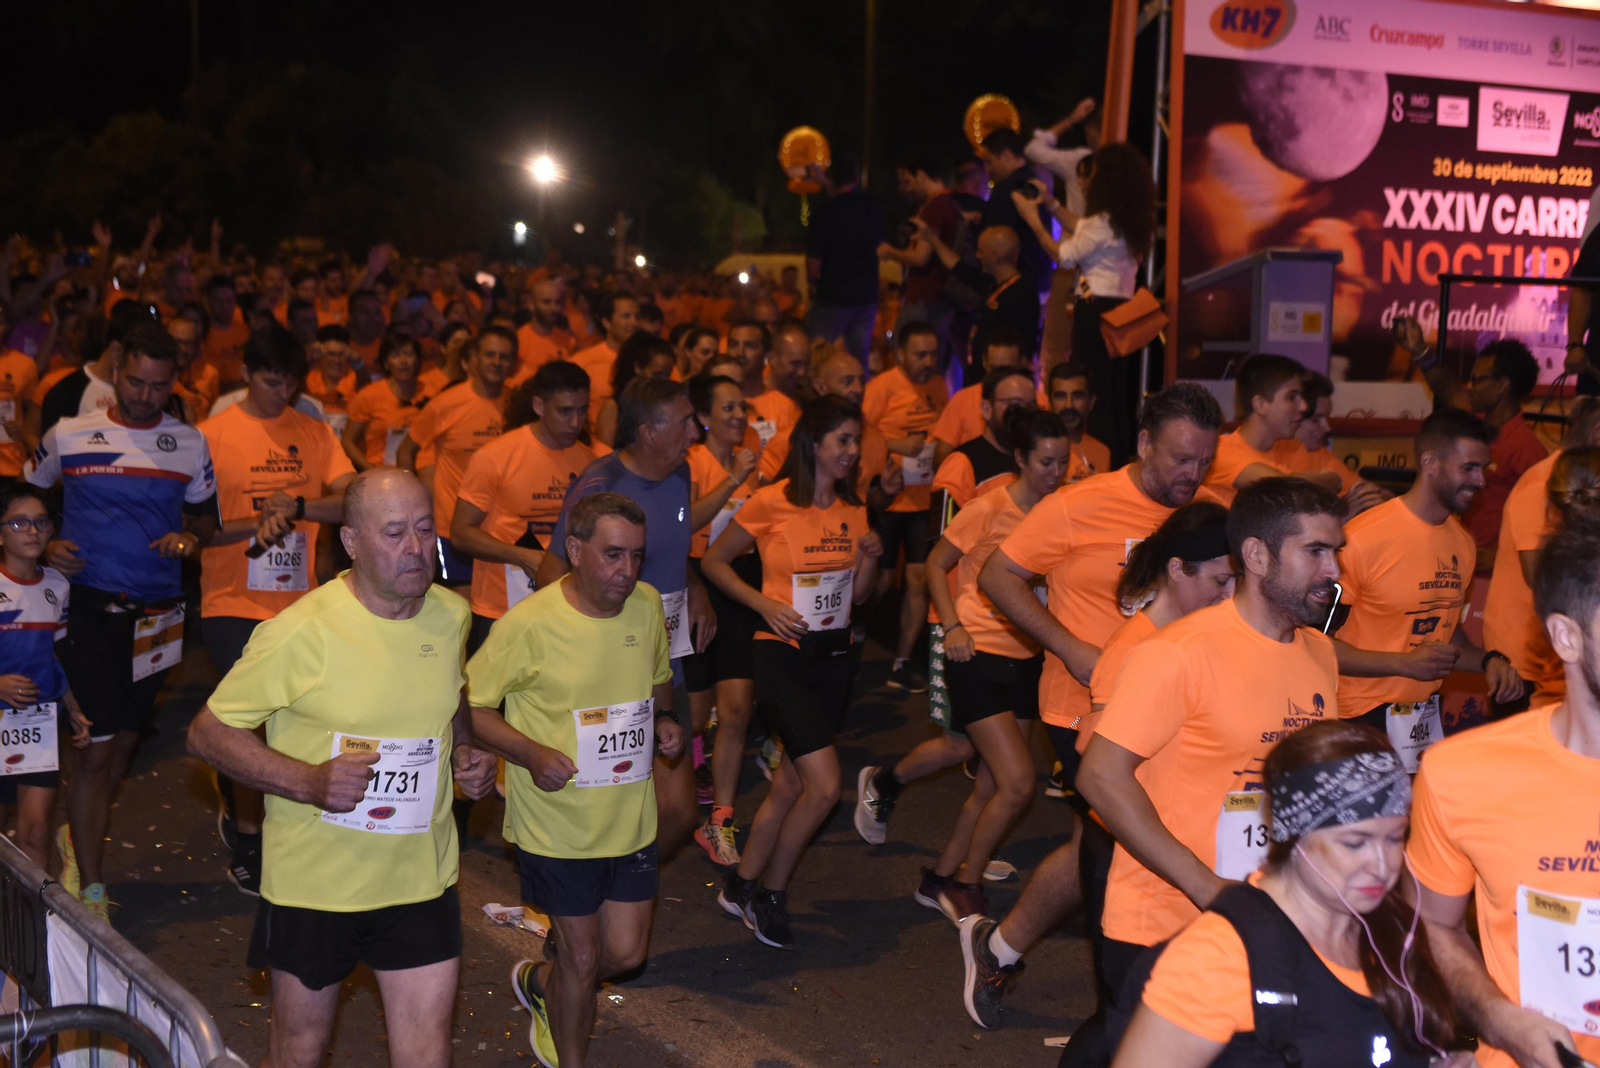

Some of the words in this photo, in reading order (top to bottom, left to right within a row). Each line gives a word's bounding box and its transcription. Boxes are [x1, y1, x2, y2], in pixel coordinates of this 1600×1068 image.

[1315, 15, 1351, 36] ABC
[1370, 24, 1445, 51] Cruzcampo
[1433, 157, 1452, 177] 30
[1454, 160, 1473, 179] de
[1475, 161, 1558, 186] septiembre
[1559, 165, 1593, 187] 2022
[1383, 187, 1490, 233] XXXIV
[1382, 239, 1580, 291] NOCTUR
[804, 545, 837, 553] SEVILLA
[1419, 581, 1449, 590] SEVILLA
[815, 592, 842, 610] 5105
[2, 727, 42, 747] 0385
[598, 727, 645, 754] 21730
[1558, 943, 1600, 977] 13
